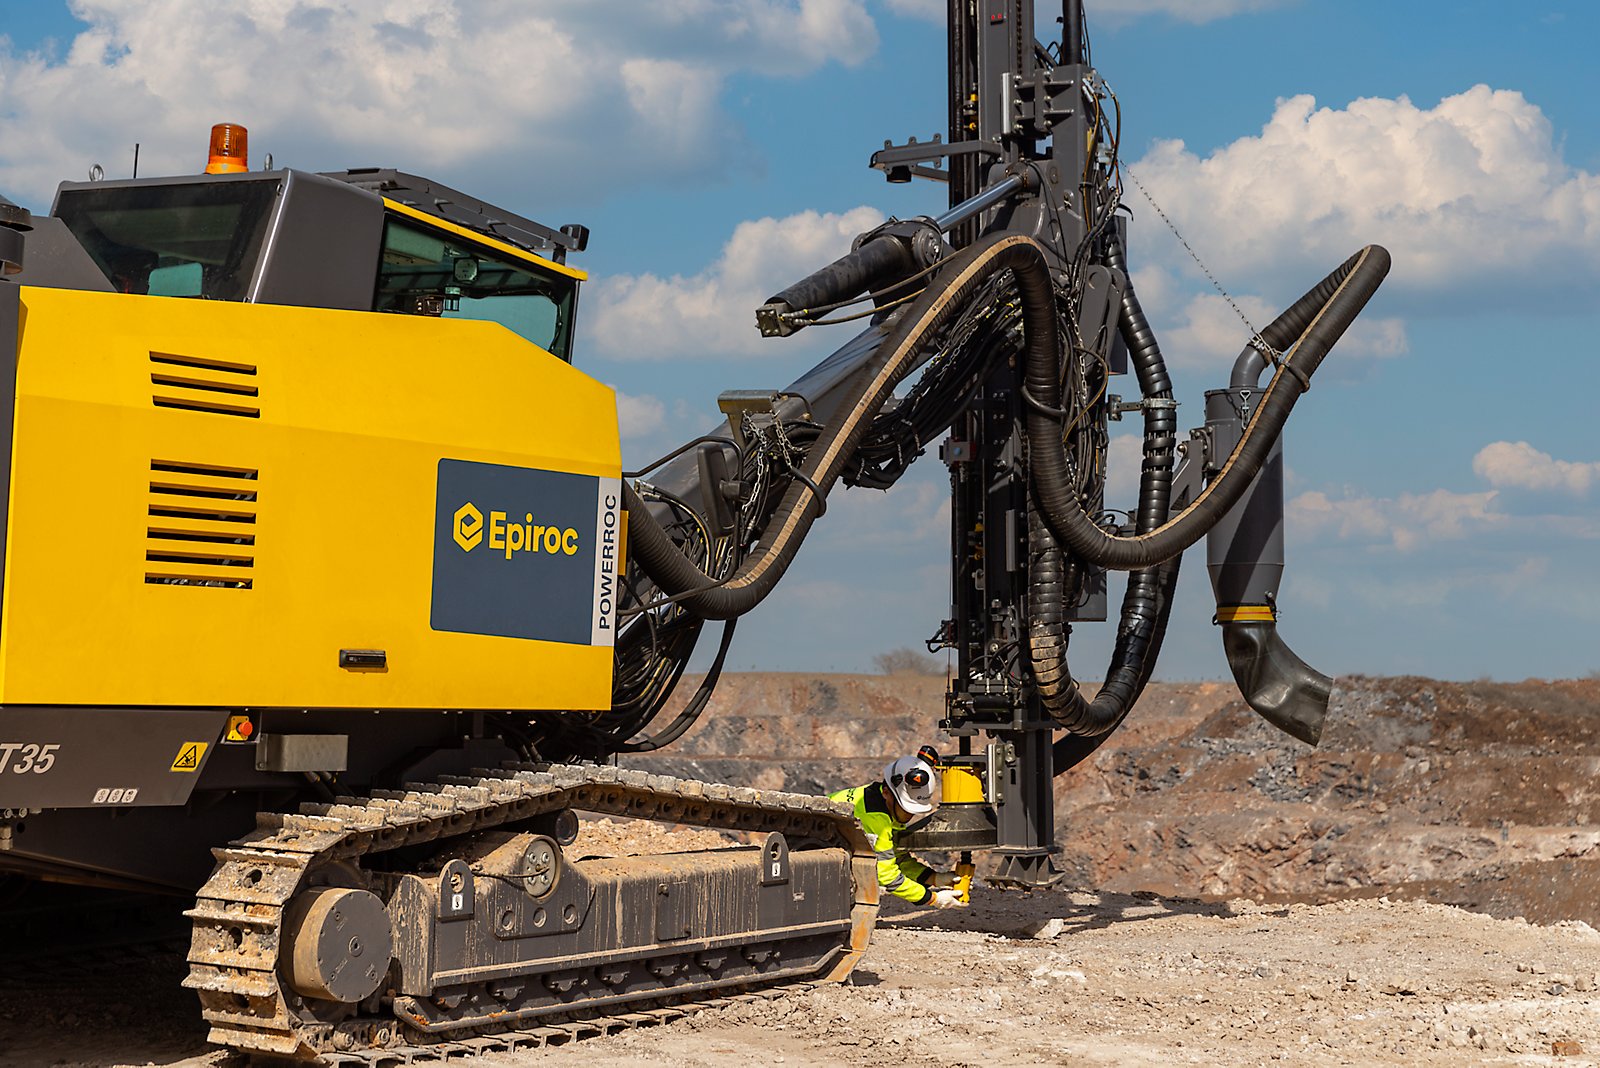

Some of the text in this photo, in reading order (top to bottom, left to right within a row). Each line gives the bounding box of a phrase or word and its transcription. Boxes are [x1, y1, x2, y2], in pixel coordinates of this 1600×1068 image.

[489, 511, 579, 560] Epiroc
[599, 494, 616, 630] POWERROC
[0, 743, 61, 774] T35
